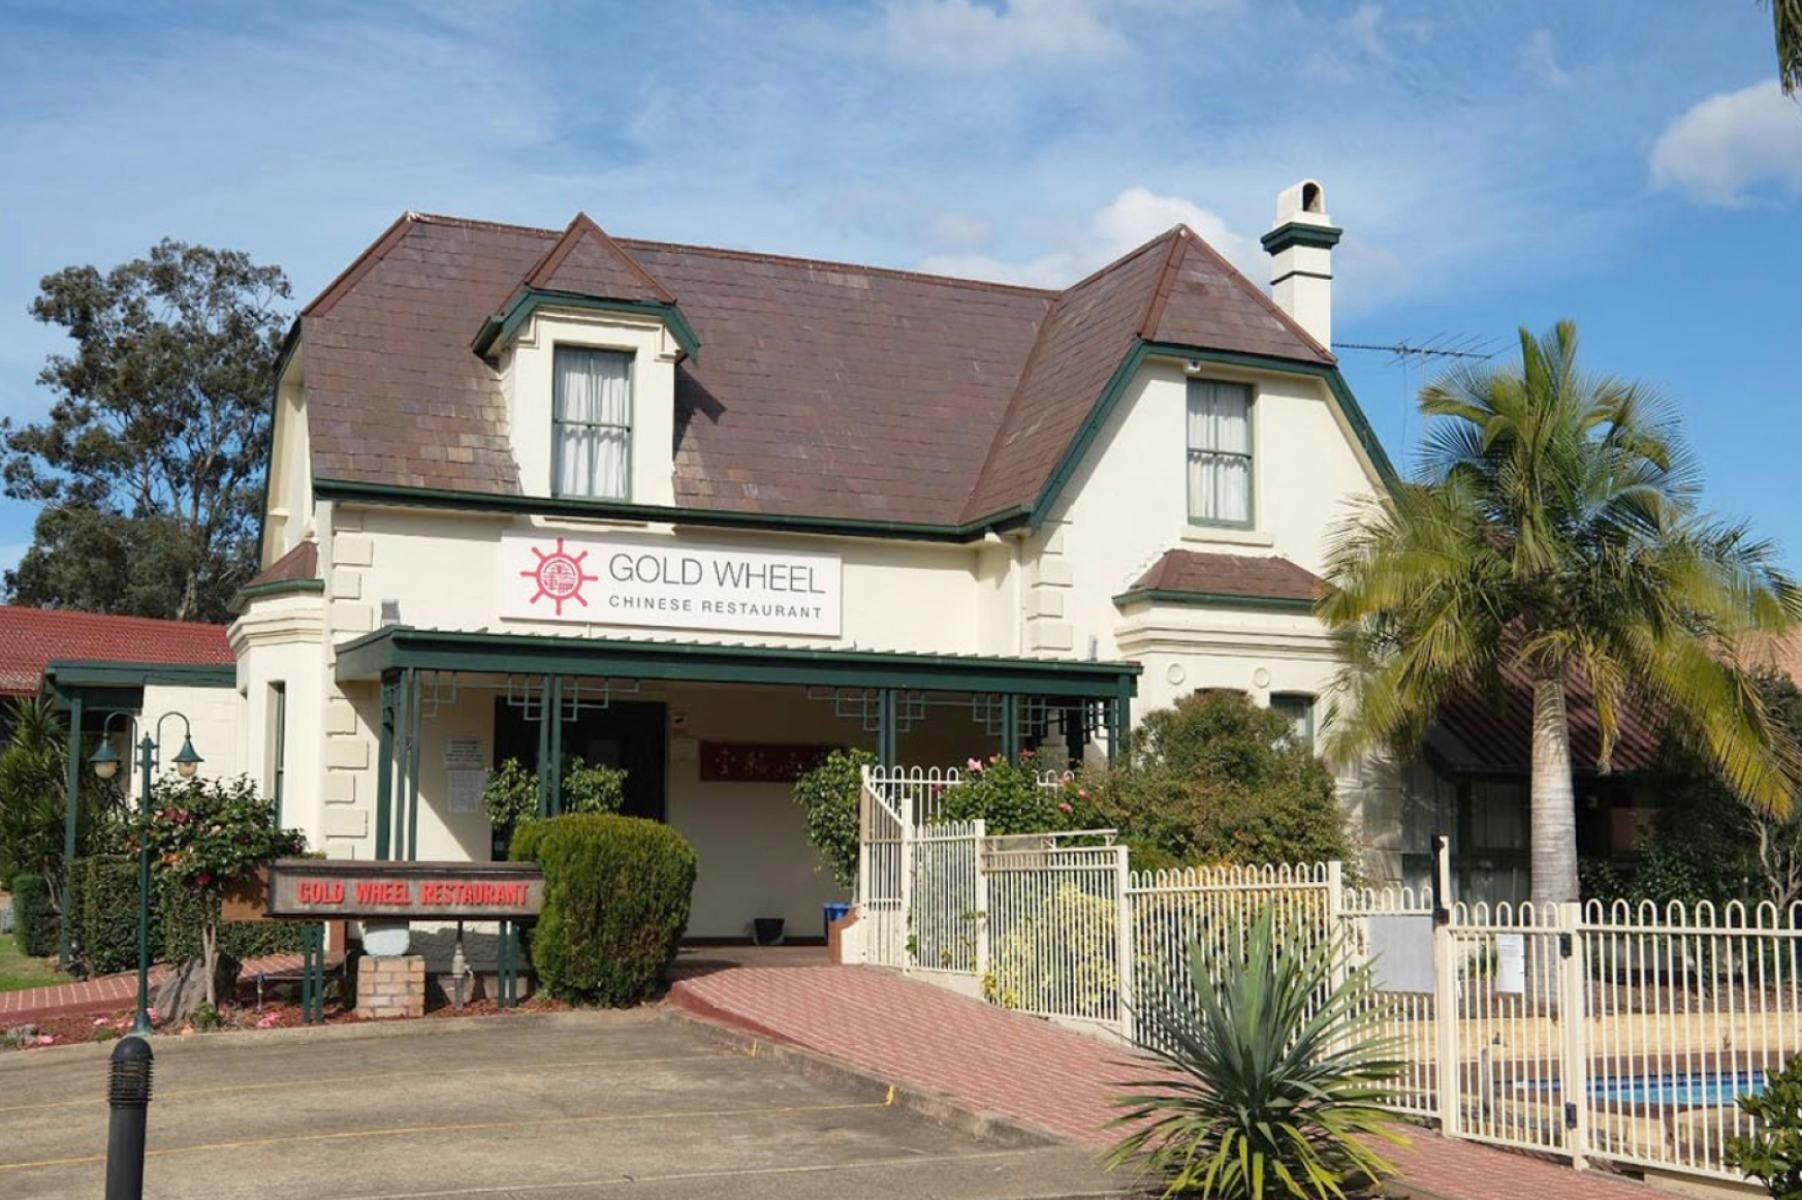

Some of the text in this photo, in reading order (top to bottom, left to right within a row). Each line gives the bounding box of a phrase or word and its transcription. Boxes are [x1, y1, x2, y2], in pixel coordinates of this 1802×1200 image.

[609, 553, 703, 585] GOLD
[713, 560, 826, 593] WHEEL
[609, 595, 822, 619] CHINESE RESTAURANT
[298, 880, 528, 905] GOLD WHEEL RESTAURANT
